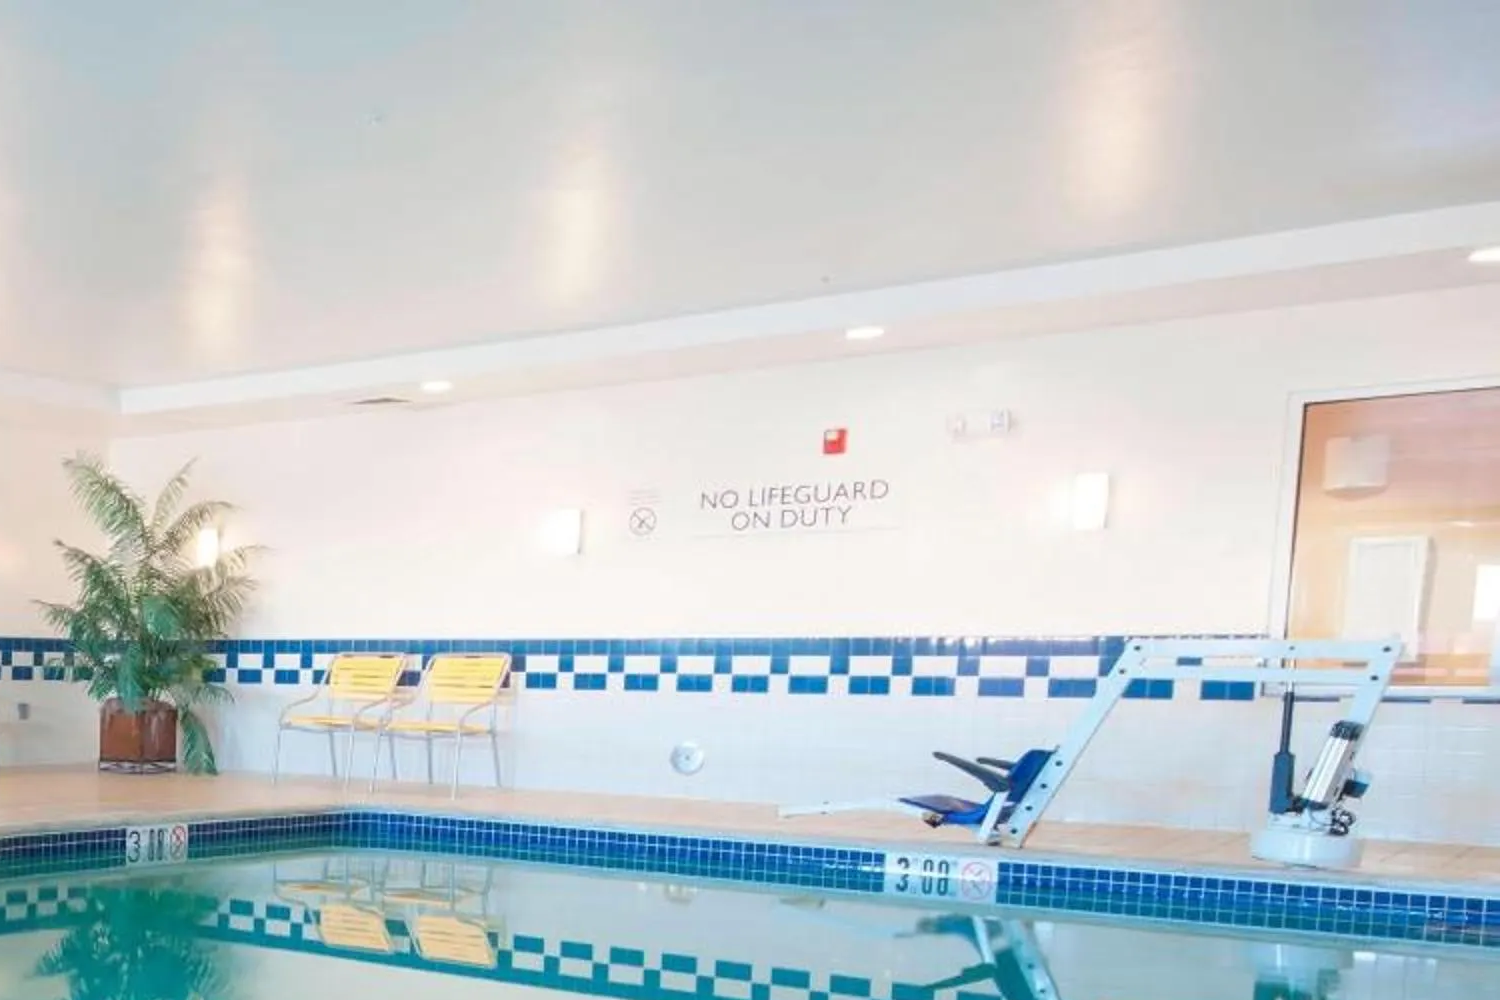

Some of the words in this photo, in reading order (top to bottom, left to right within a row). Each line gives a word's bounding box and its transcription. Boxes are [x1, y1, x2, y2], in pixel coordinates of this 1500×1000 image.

[700, 489, 739, 510] NO
[749, 479, 889, 508] LIFEGUARD
[731, 511, 771, 531] ON
[780, 505, 852, 528] DUTY
